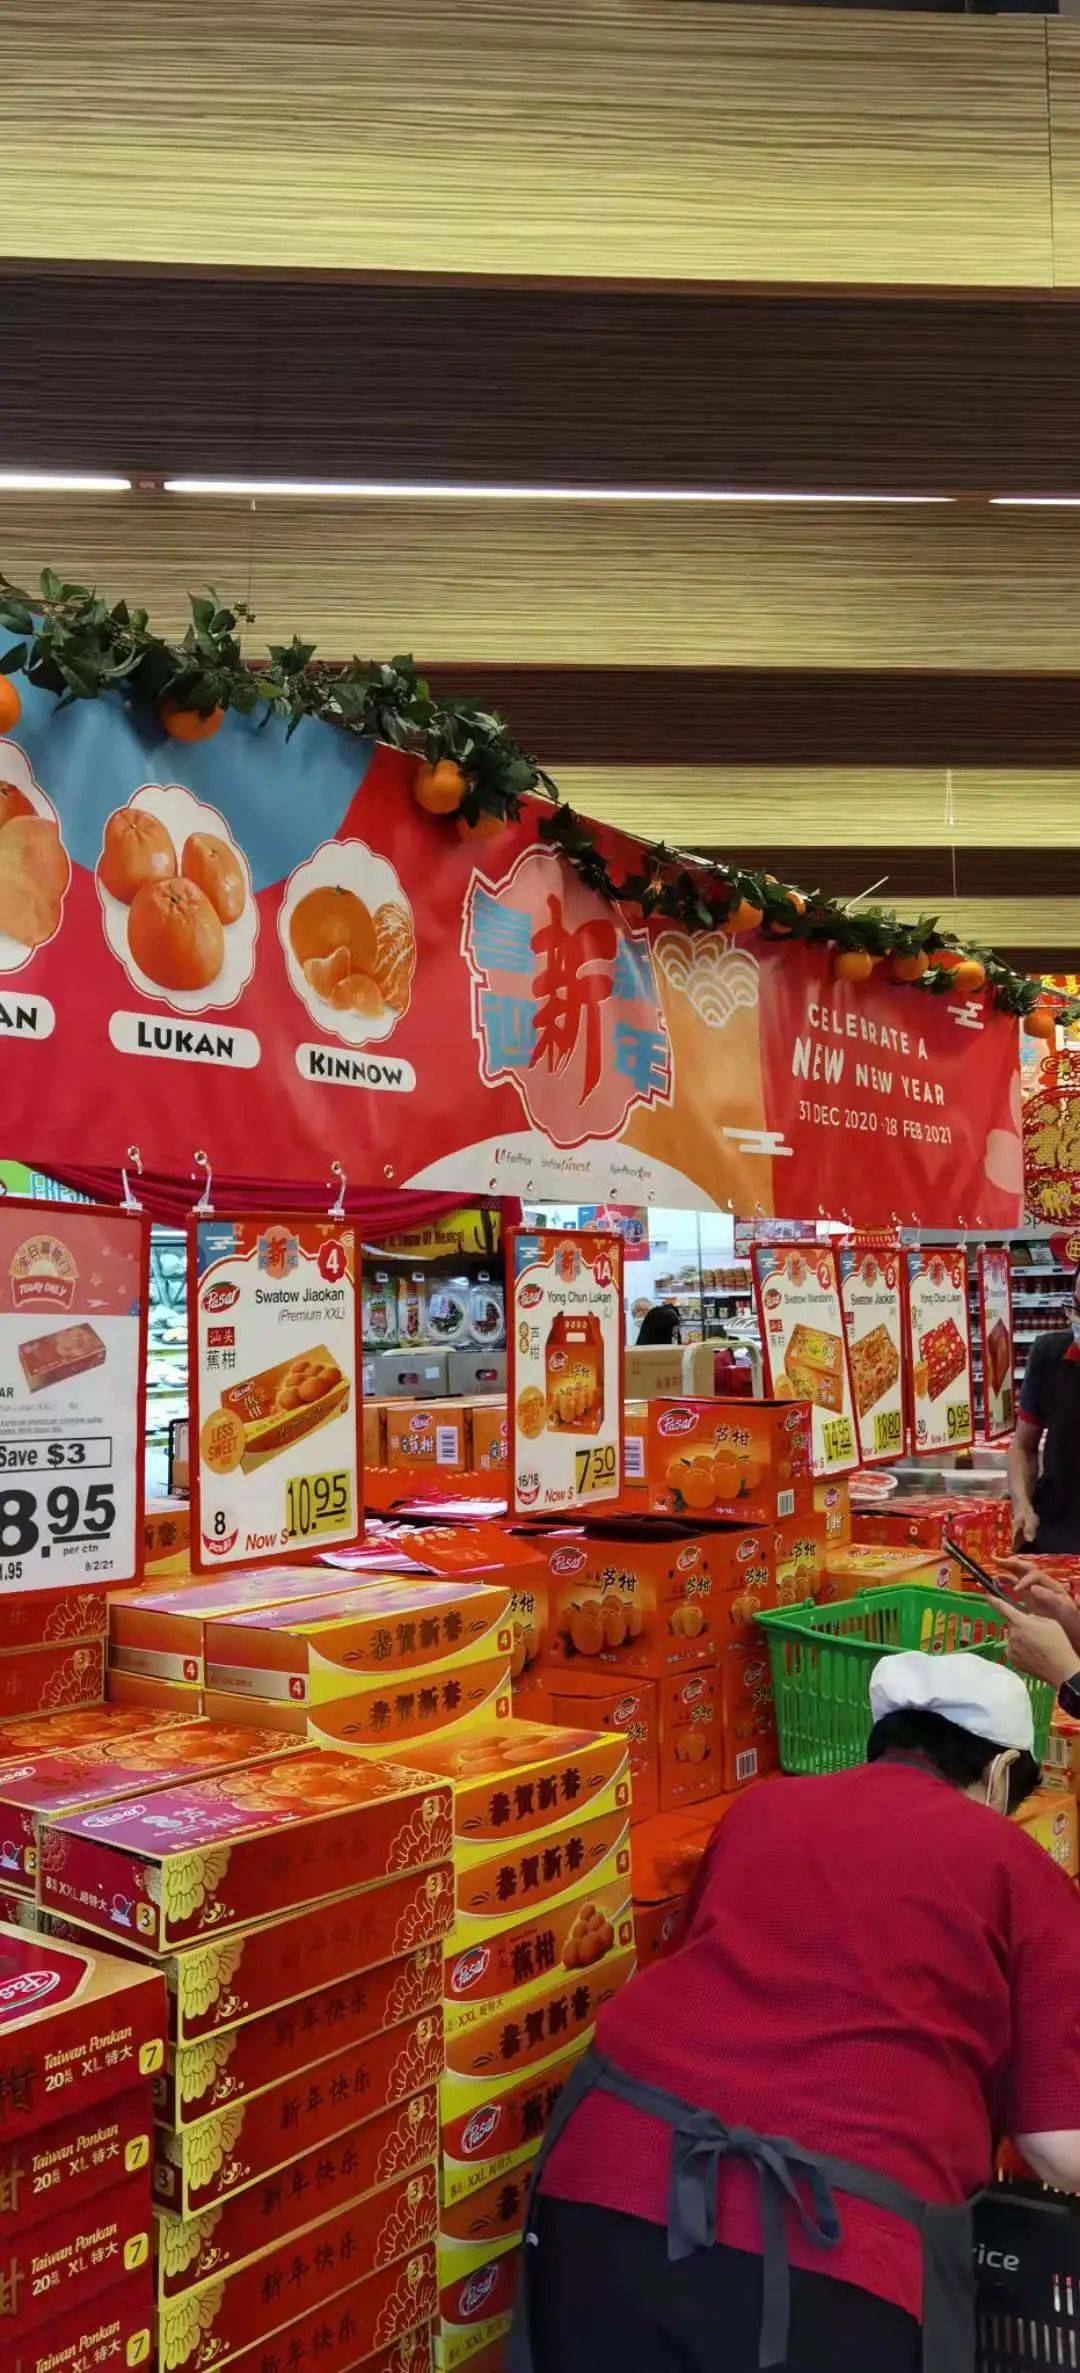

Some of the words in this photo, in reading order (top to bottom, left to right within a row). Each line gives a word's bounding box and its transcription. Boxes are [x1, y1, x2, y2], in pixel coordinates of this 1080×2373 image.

[529, 893, 618, 1107] 新
[137, 1021, 234, 1059] LUKAN
[807, 1002, 910, 1055] CELEBRATE
[918, 1038, 928, 1060] A
[309, 1051, 403, 1086] KINNOW
[792, 1037, 845, 1085] NEW
[855, 1063, 892, 1094] NEW
[901, 1075, 945, 1106] YEAR
[800, 1100, 811, 1121] 31
[814, 1104, 840, 1126] DEC
[844, 1109, 877, 1132] 2020
[903, 1120, 923, 1140] FEB
[925, 1125, 952, 1144] 2021
[326, 1248, 340, 1274] 4
[597, 1260, 609, 1280] 1A
[822, 1265, 829, 1285] 2
[19, 1282, 44, 1297] TODAY
[44, 1281, 67, 1297] ONLY
[255, 1288, 300, 1304] Swatow
[302, 1287, 345, 1303] Jiaokan
[547, 1291, 566, 1306] Yong
[568, 1291, 587, 1303] Chun
[589, 1292, 612, 1304] Lukan
[278, 1308, 322, 1326] (Premium
[211, 1422, 235, 1444] LESS
[947, 1404, 970, 1439] 9.95
[47, 1442, 86, 1470] $3
[208, 1435, 238, 1461] SWEET
[575, 1446, 616, 1494] 7.50
[287, 1474, 348, 1537] 10.95
[545, 1490, 566, 1504] Now
[214, 1511, 226, 1536] 8
[63, 1545, 79, 1557] per
[82, 1544, 99, 1554] ctn
[246, 1533, 277, 1551] Now
[187, 1660, 196, 1678] 4
[292, 1679, 302, 1696] 4
[428, 1800, 435, 1815] 3
[28, 1850, 36, 1869] 3
[59, 1881, 79, 1901] XXL
[430, 1877, 437, 1892] 3
[142, 1908, 150, 1927] 3
[421, 2021, 428, 2034] 3
[458, 2010, 477, 2028] XXL
[44, 2043, 87, 2072] Taiwan
[90, 2026, 132, 2052] Ponkan
[145, 2045, 157, 2068] 7
[81, 2058, 103, 2077] XL
[105, 2045, 133, 2067] 特大
[413, 2101, 420, 2113] 3
[32, 2143, 74, 2173] Taiwan
[76, 2124, 119, 2153] Ponkan
[69, 2159, 89, 2177] XL
[92, 2142, 120, 2166] 特大
[131, 2142, 143, 2165] 7
[159, 2168, 170, 2187] 3
[412, 2182, 420, 2194] 3
[31, 2245, 73, 2275] Taiwan
[75, 2223, 118, 2253] Ponkan
[67, 2260, 88, 2278] XL
[91, 2241, 119, 2265] 特大
[131, 2240, 142, 2263] 7
[972, 2243, 1020, 2272] ice
[412, 2260, 420, 2273] 3
[35, 2343, 76, 2373] Taiwan
[79, 2320, 121, 2351] Ponkan
[93, 2338, 122, 2364] 特大
[133, 2337, 146, 2360] 7
